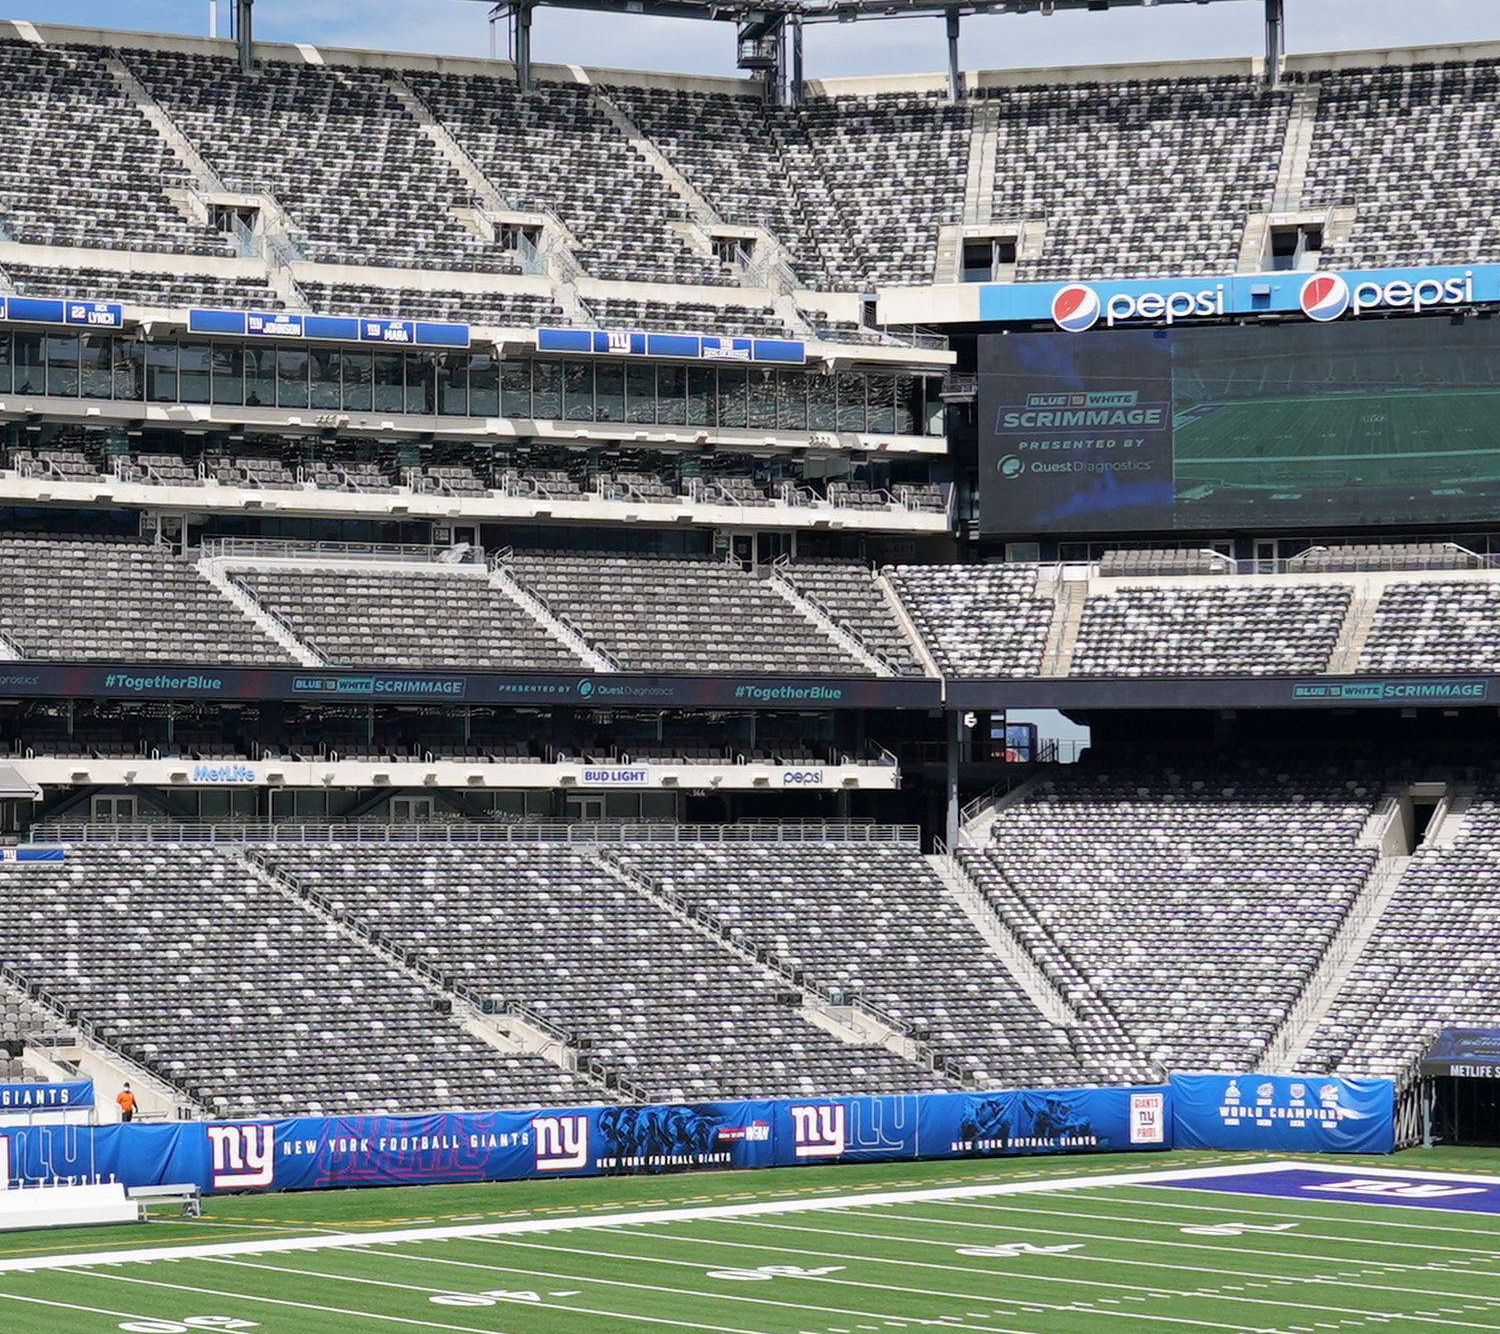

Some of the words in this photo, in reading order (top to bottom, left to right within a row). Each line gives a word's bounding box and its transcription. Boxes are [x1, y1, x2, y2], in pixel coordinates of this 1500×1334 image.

[1354, 270, 1472, 315] pepsi
[71, 305, 86, 318] 22
[1108, 283, 1224, 326] pepsi
[89, 311, 115, 326] LYNCH
[607, 331, 632, 353] ny
[1029, 395, 1067, 407] BLUE
[1088, 393, 1135, 405] WHITE
[1003, 409, 1162, 428] SCRIMMAGE
[1018, 440, 1117, 450] PRESENTED
[1123, 438, 1145, 447] BY
[105, 675, 221, 691] #TogetherBlue
[375, 681, 462, 693] SCRIMMAGE
[1384, 685, 1484, 697] SCRIMMAGE
[735, 686, 841, 701] #TogetherBlue
[194, 765, 255, 782] MetLife
[585, 771, 609, 781] BUD
[612, 771, 646, 781] LIGHT
[783, 770, 823, 786] pepsi
[1450, 1065, 1492, 1078] METLIFE
[3, 1088, 69, 1105] GIANTS
[1219, 1106, 1262, 1119] WORLD
[1267, 1107, 1343, 1121] CHAMPIONS
[791, 1104, 845, 1157] ny
[530, 1114, 588, 1170] ny
[207, 1124, 275, 1188] ny
[284, 1140, 317, 1156] NEW
[329, 1138, 369, 1153] YORK
[380, 1135, 458, 1152] FOOTBALL
[471, 1132, 529, 1147] GIANTS
